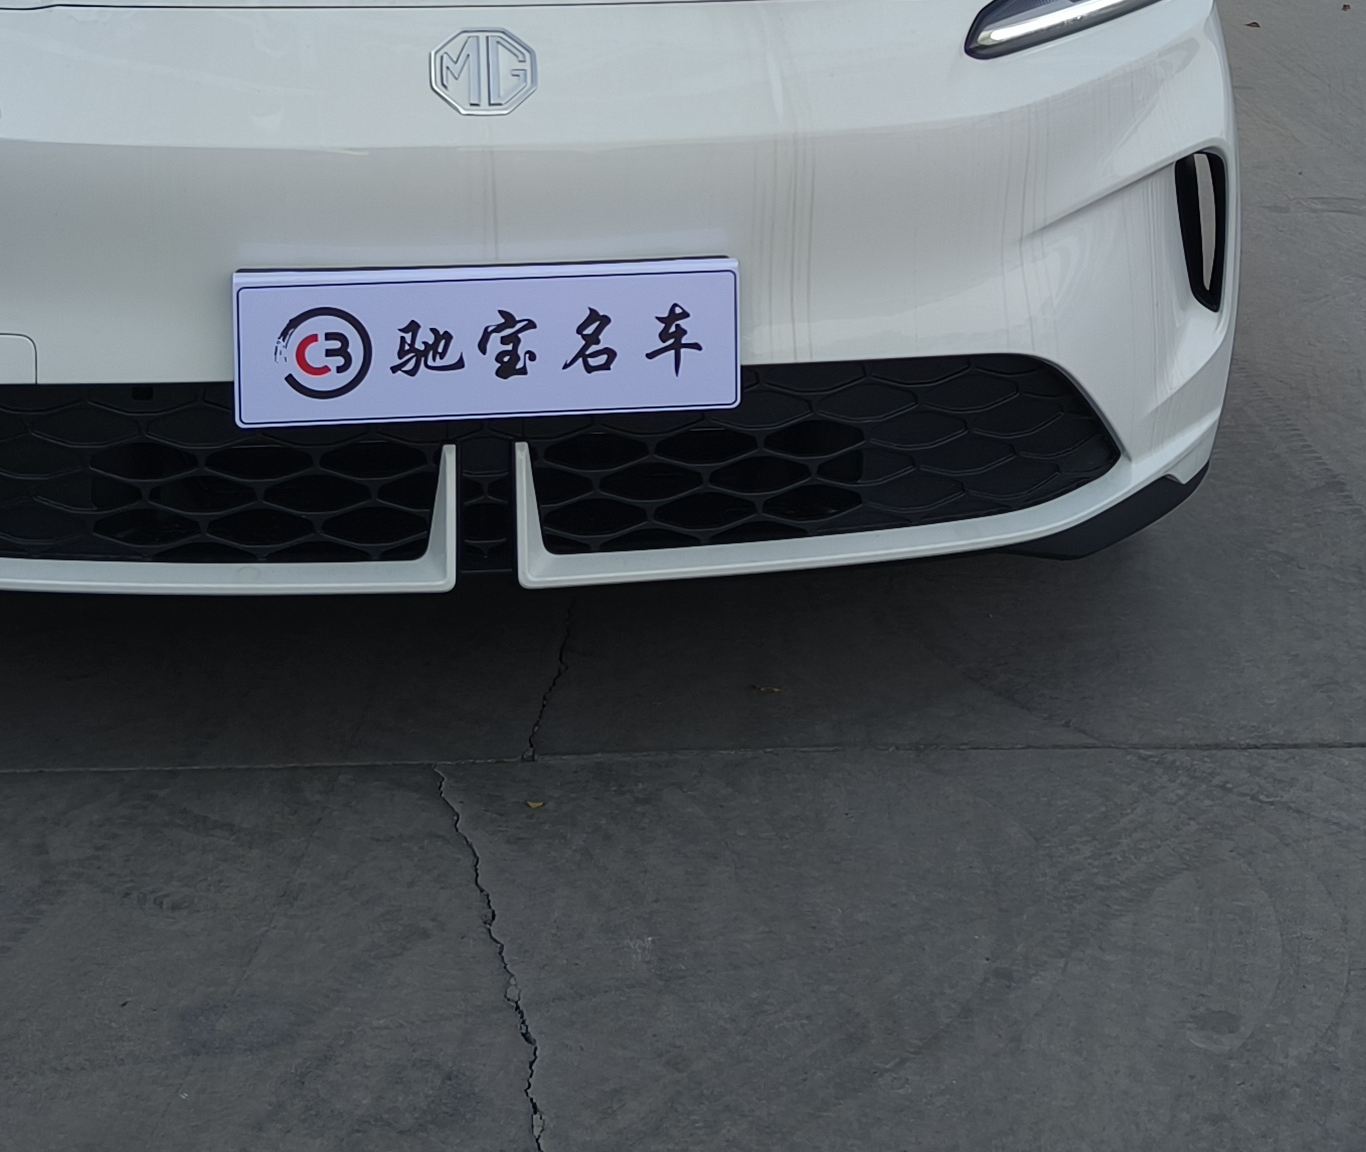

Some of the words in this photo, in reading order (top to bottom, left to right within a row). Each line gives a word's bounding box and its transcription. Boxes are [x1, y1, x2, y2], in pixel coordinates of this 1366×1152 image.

[439, 34, 528, 107] MG
[390, 301, 704, 380] 驰宝名车
